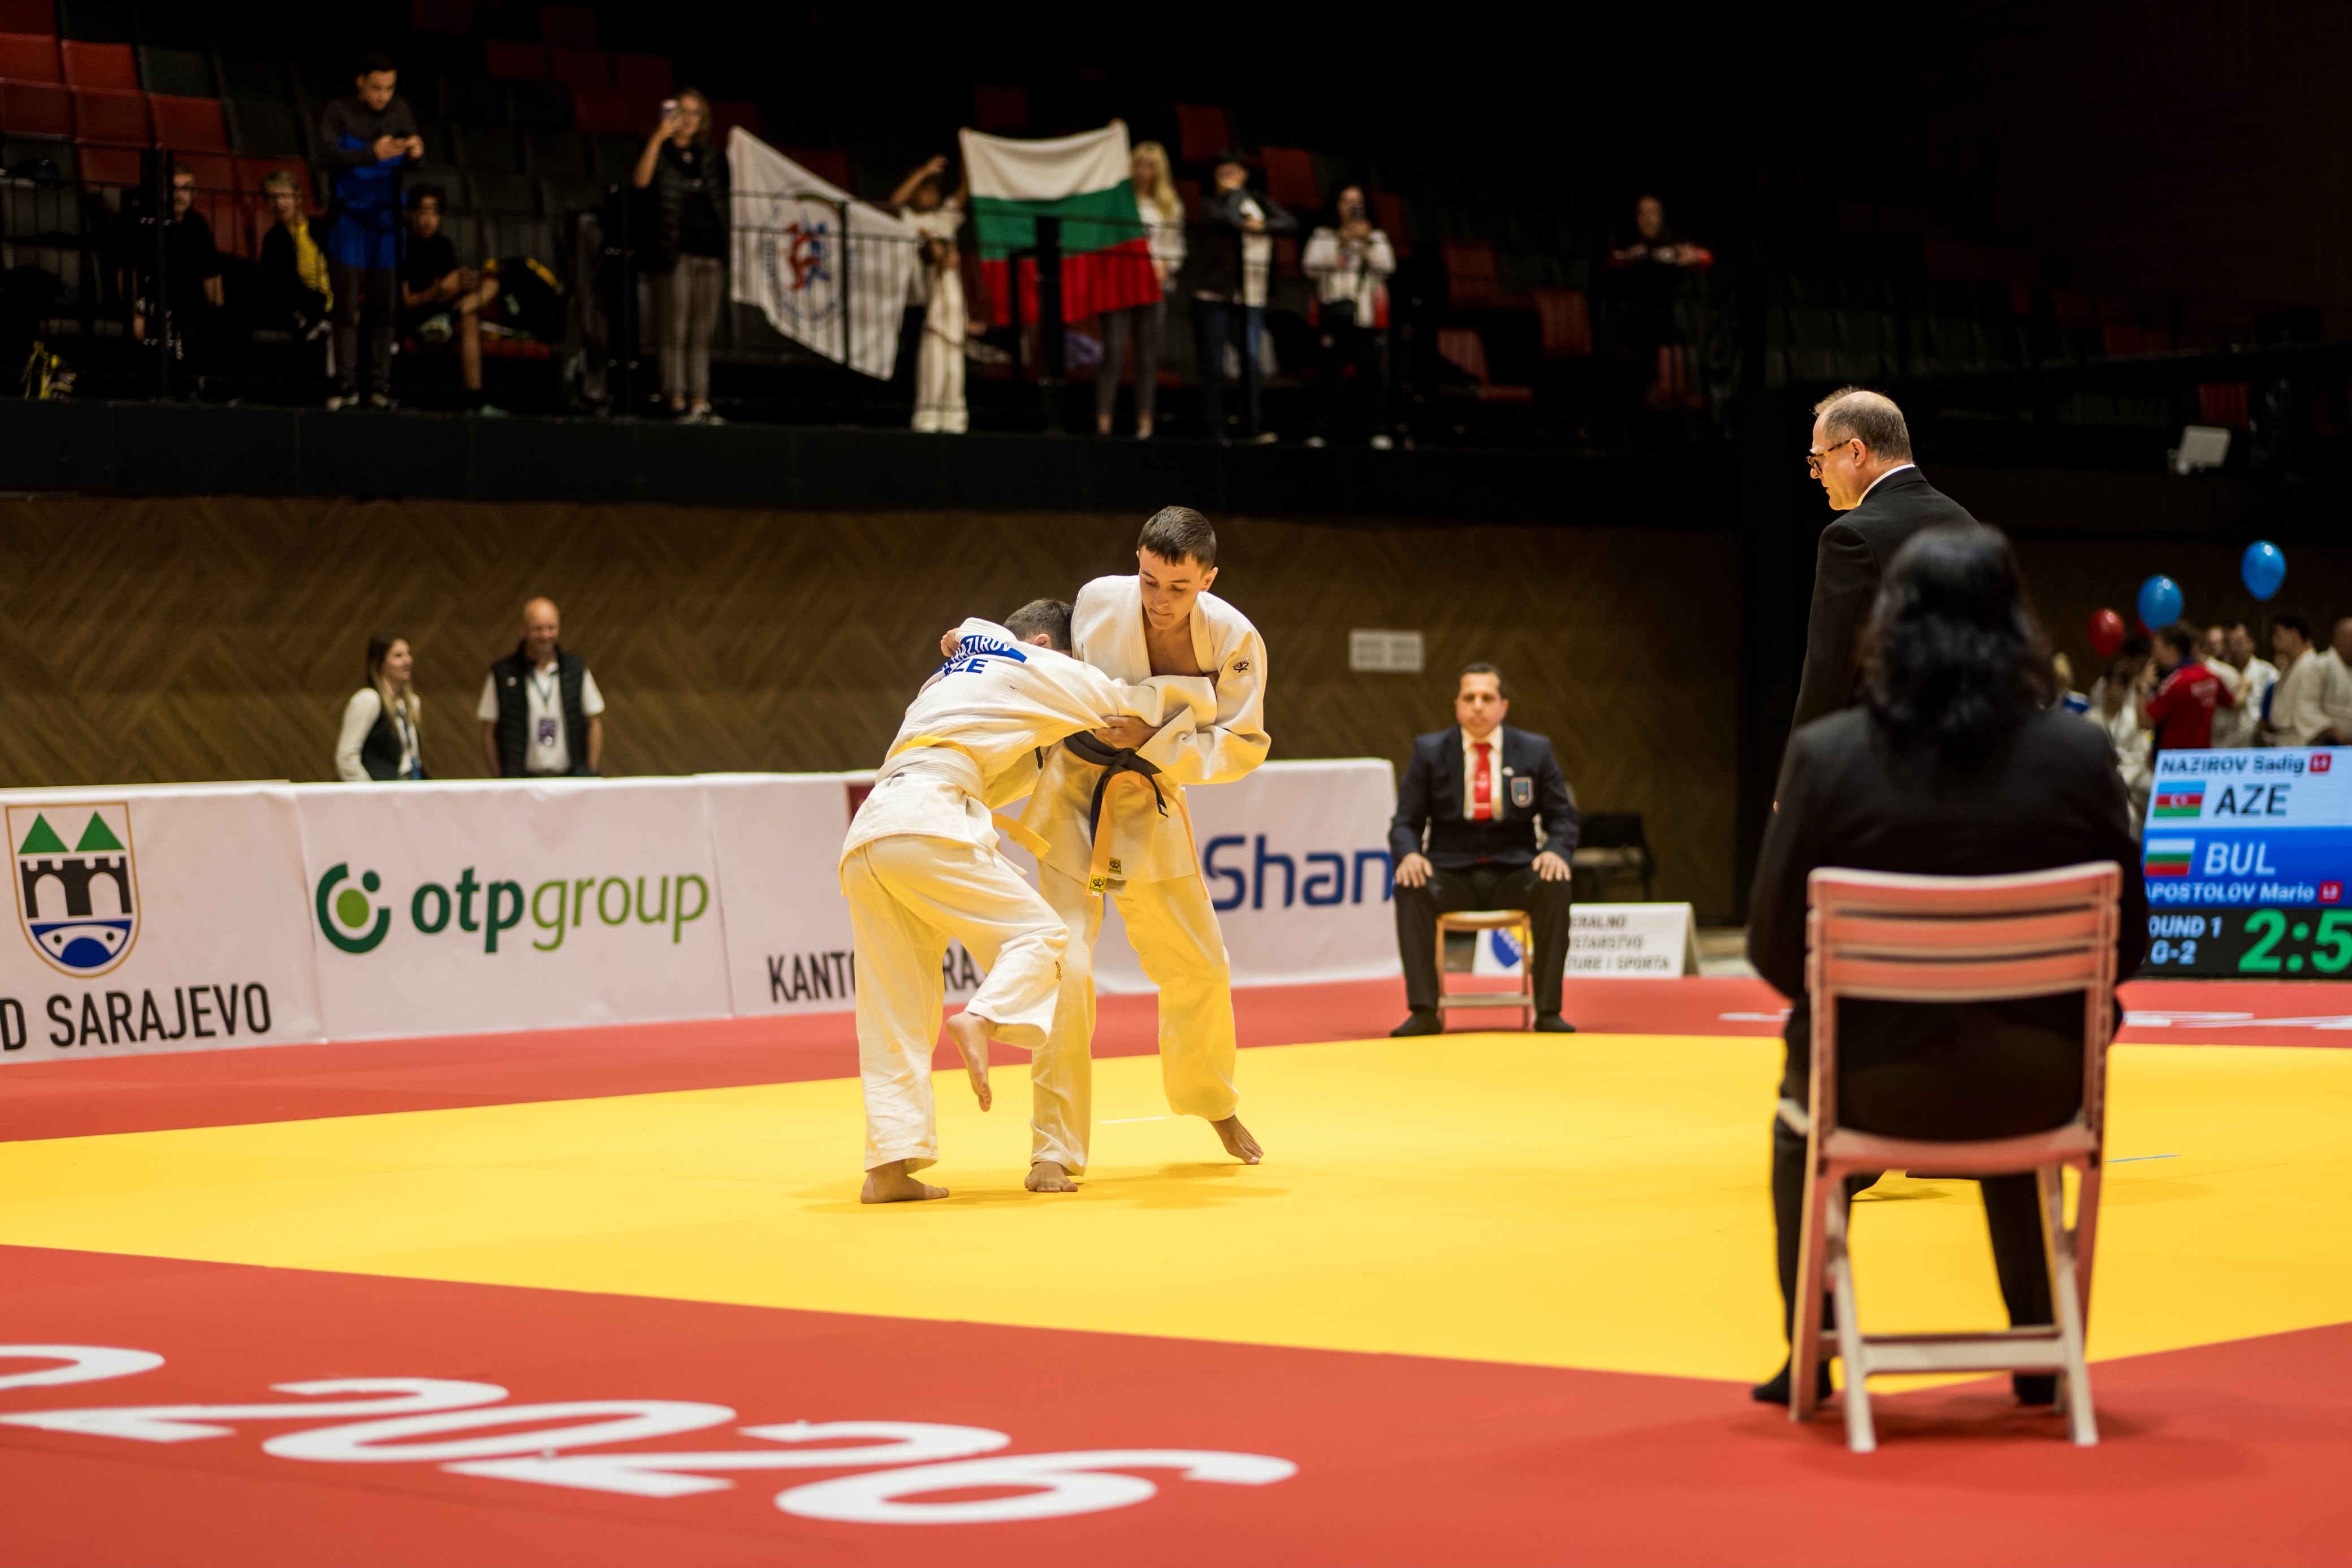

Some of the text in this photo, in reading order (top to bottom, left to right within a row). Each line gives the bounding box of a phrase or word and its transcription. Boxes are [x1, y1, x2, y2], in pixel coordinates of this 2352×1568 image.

[2161, 756, 2248, 774] NAZIROV
[2254, 756, 2305, 776] Sadig
[2215, 783, 2290, 816] AZE
[2204, 842, 2276, 876] BUL
[2259, 881, 2316, 902] Mario
[410, 865, 710, 954] otpgroup
[1570, 915, 1627, 929] ERALNO
[2147, 915, 2223, 938] OUND 1
[1571, 934, 1644, 950] STARSTVO
[1568, 955, 1602, 970] TURE
[46, 982, 271, 1047] SARAJEVO
[0, 1377, 1299, 1524] 2026
